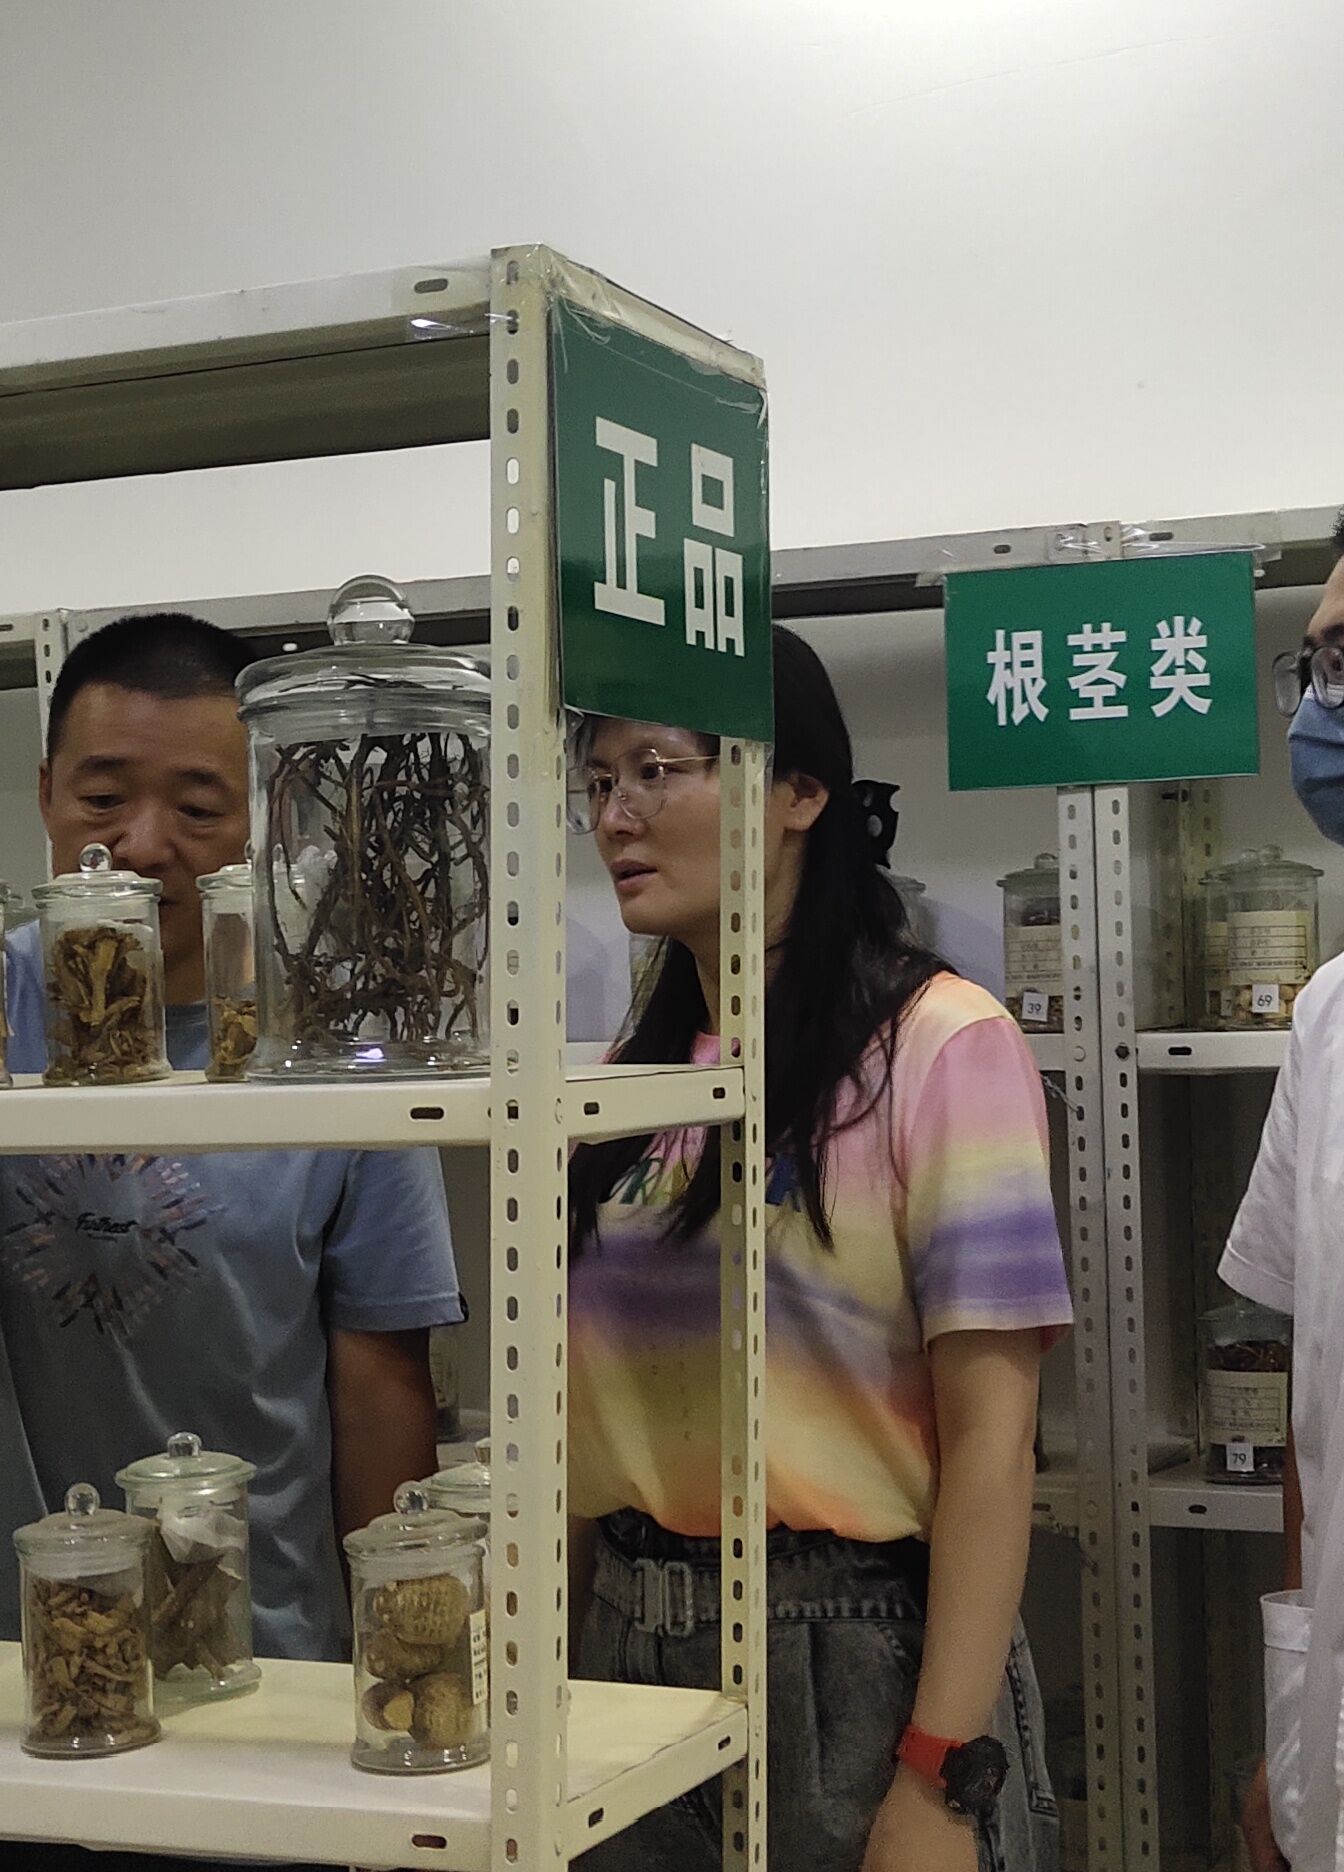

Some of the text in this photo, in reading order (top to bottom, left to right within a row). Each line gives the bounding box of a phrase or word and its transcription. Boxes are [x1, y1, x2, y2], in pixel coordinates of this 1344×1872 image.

[594, 416, 746, 657] 正品
[987, 615, 1213, 726] 根茎类
[1257, 994, 1273, 1007] 69
[1026, 1002, 1042, 1015] 39
[1232, 1452, 1247, 1465] 79
